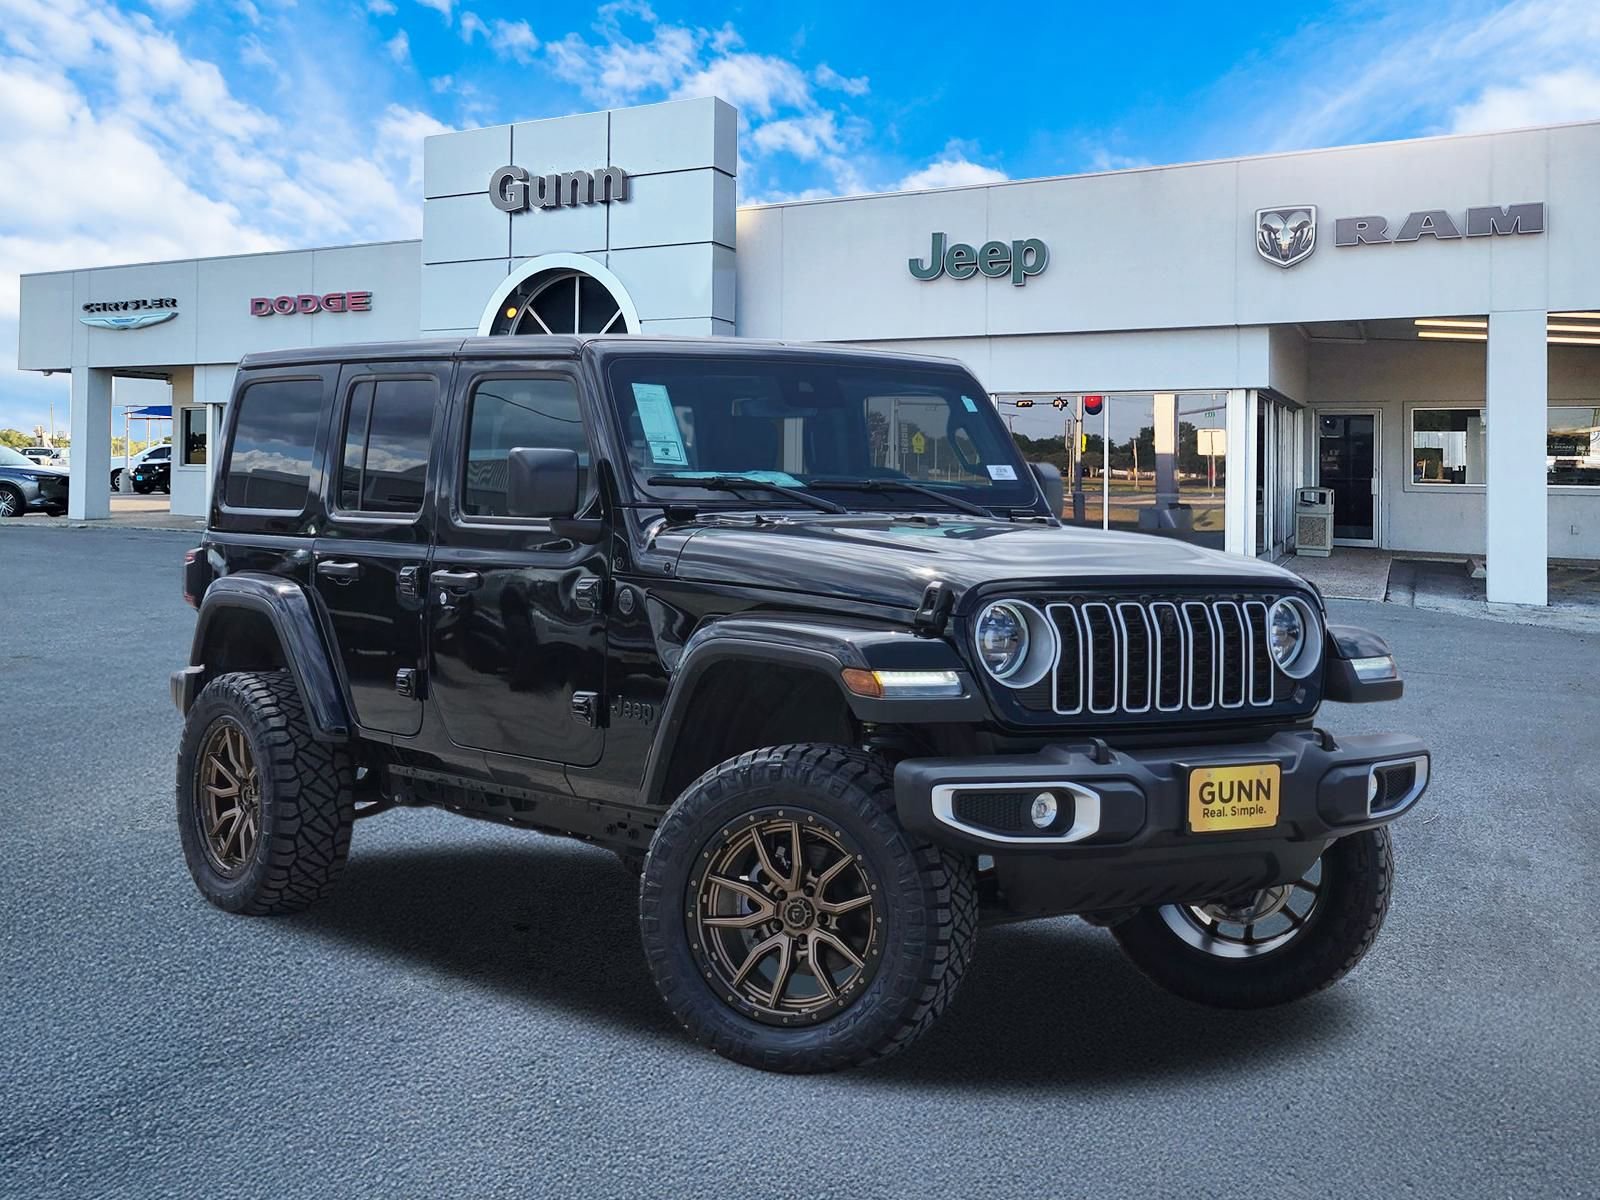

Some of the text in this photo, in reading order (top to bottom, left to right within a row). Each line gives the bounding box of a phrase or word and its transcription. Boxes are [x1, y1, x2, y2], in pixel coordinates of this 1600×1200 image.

[489, 165, 628, 213] Gunn
[1335, 202, 1545, 247] RAM
[908, 232, 1049, 286] Jeep
[82, 298, 177, 313] CHRYSLER
[250, 291, 372, 316] DODGE
[609, 694, 654, 726] Jeep
[1198, 778, 1271, 805] GUNN
[1202, 804, 1267, 818] Real. Simple.
